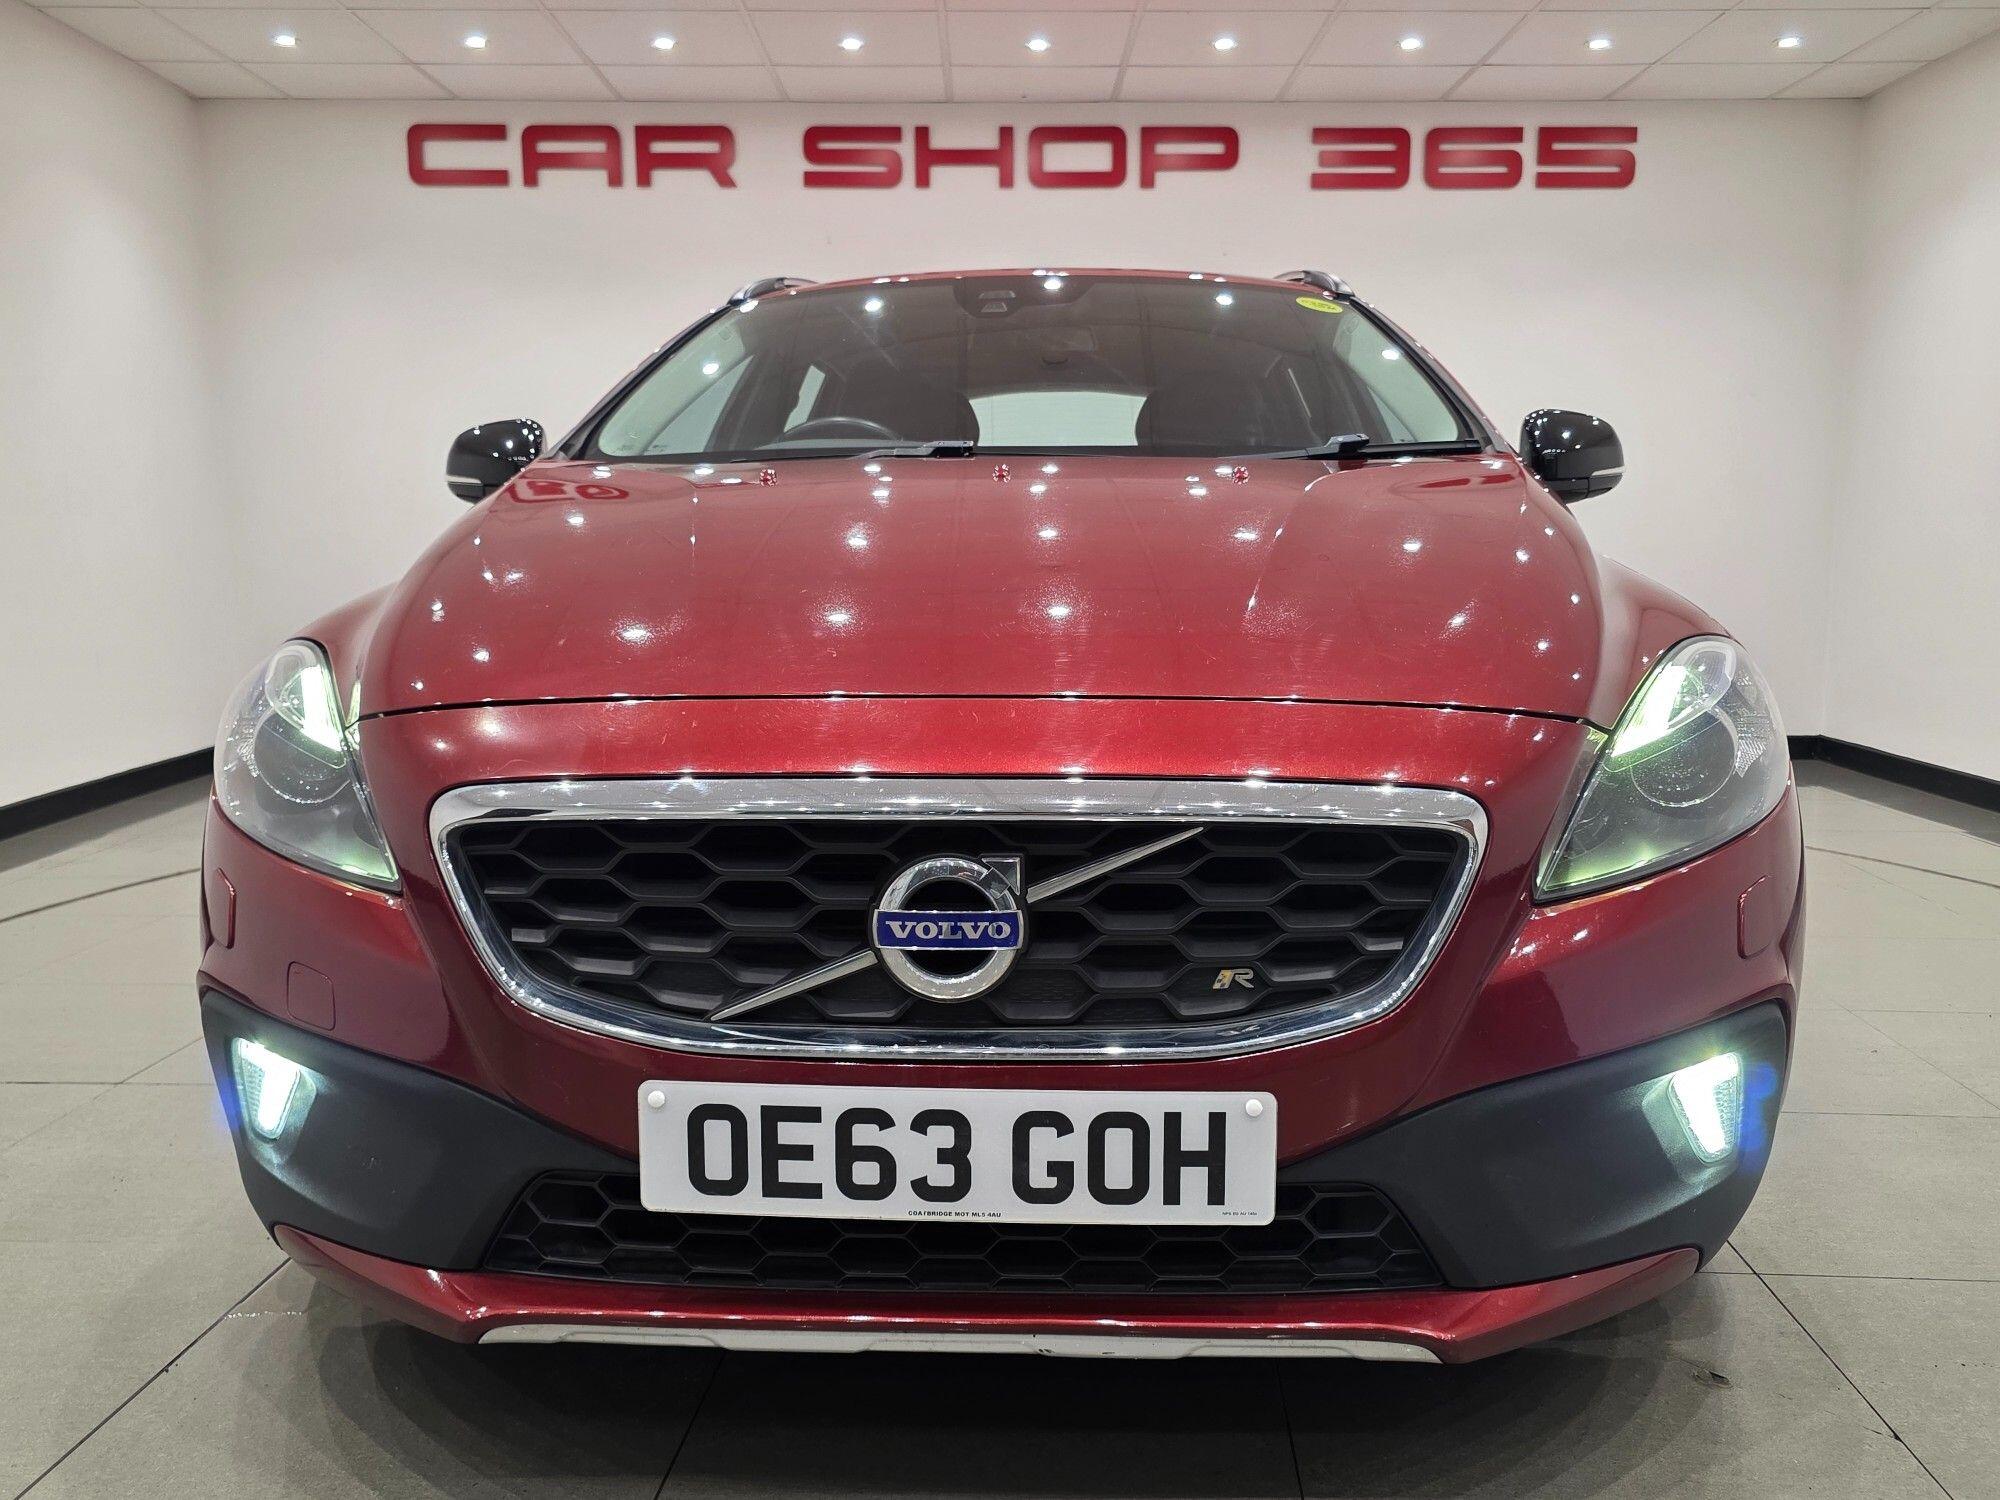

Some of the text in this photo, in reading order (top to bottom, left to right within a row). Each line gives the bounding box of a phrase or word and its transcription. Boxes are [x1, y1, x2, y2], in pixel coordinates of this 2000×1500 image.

[407, 123, 1637, 189] CAR SHOP 365
[885, 920, 1011, 940] VOLVO
[686, 1103, 1227, 1206] OE63 GOH
